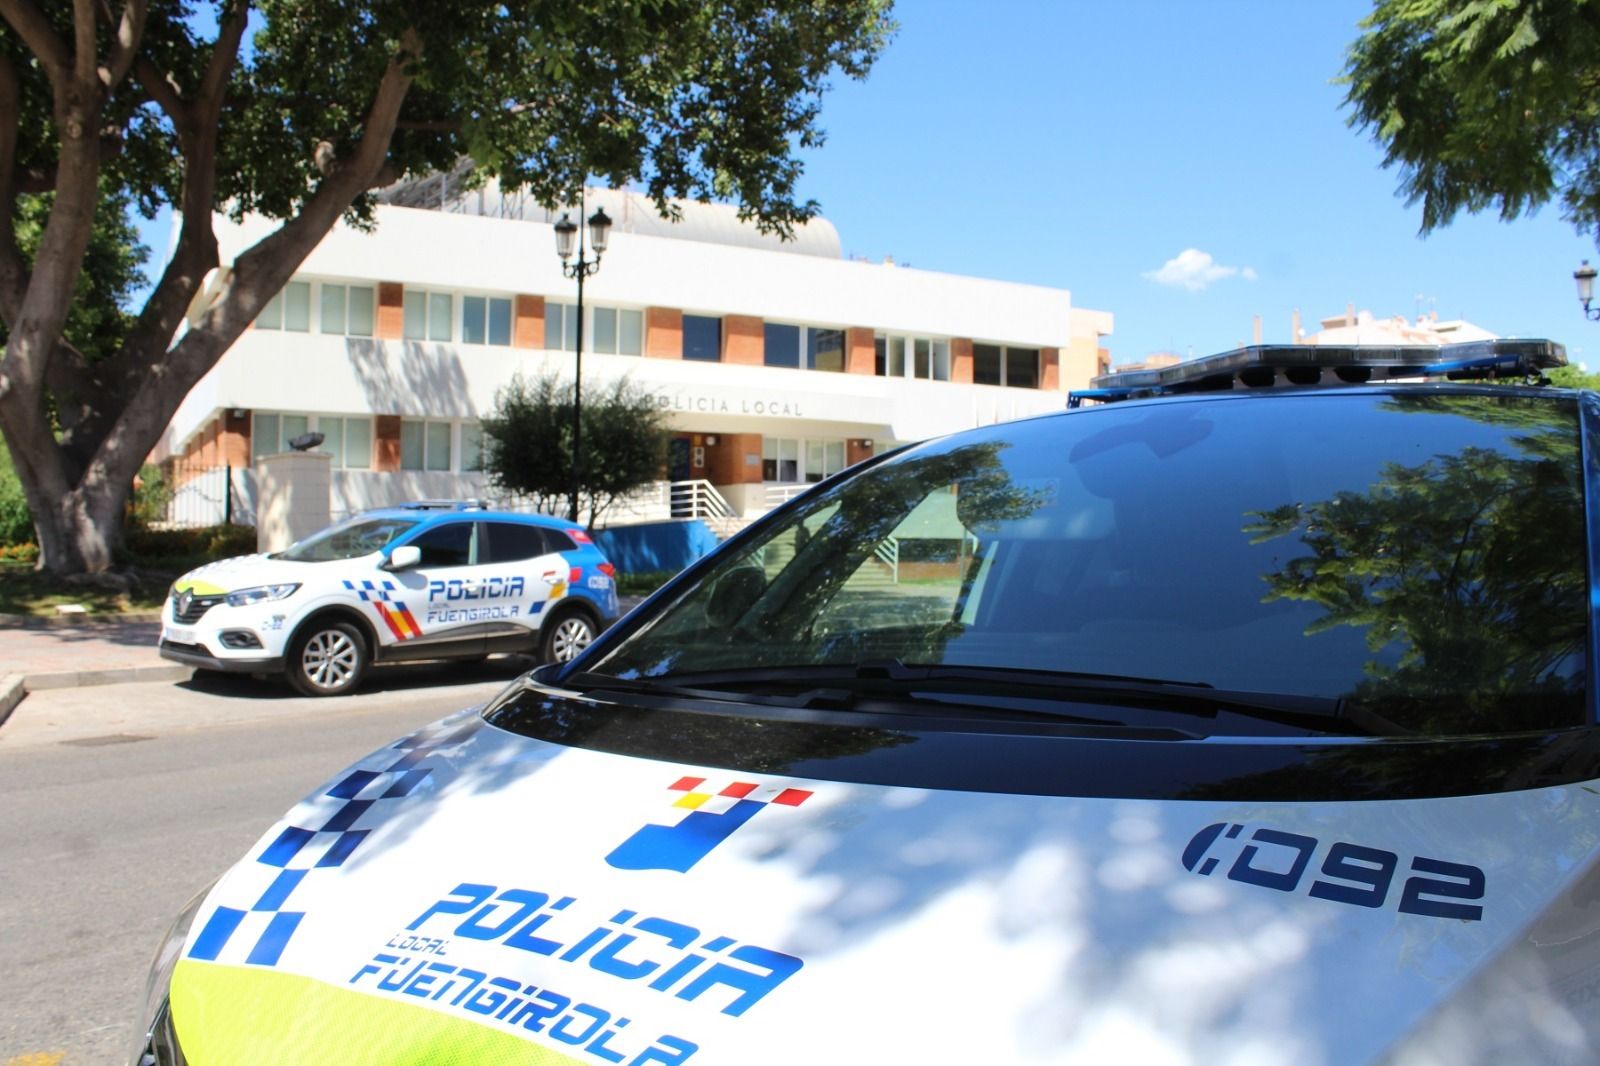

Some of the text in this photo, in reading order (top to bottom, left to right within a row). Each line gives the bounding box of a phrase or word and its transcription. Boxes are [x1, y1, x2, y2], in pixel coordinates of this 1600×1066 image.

[742, 400, 803, 417] LOCAL
[429, 576, 525, 602] POLICIA
[427, 605, 520, 623] FUENGIROLA
[1227, 828, 1486, 921] 092
[384, 934, 449, 956] LOCAL
[406, 883, 804, 1017] POLICIA
[349, 954, 699, 1066] FUENGIROLA
